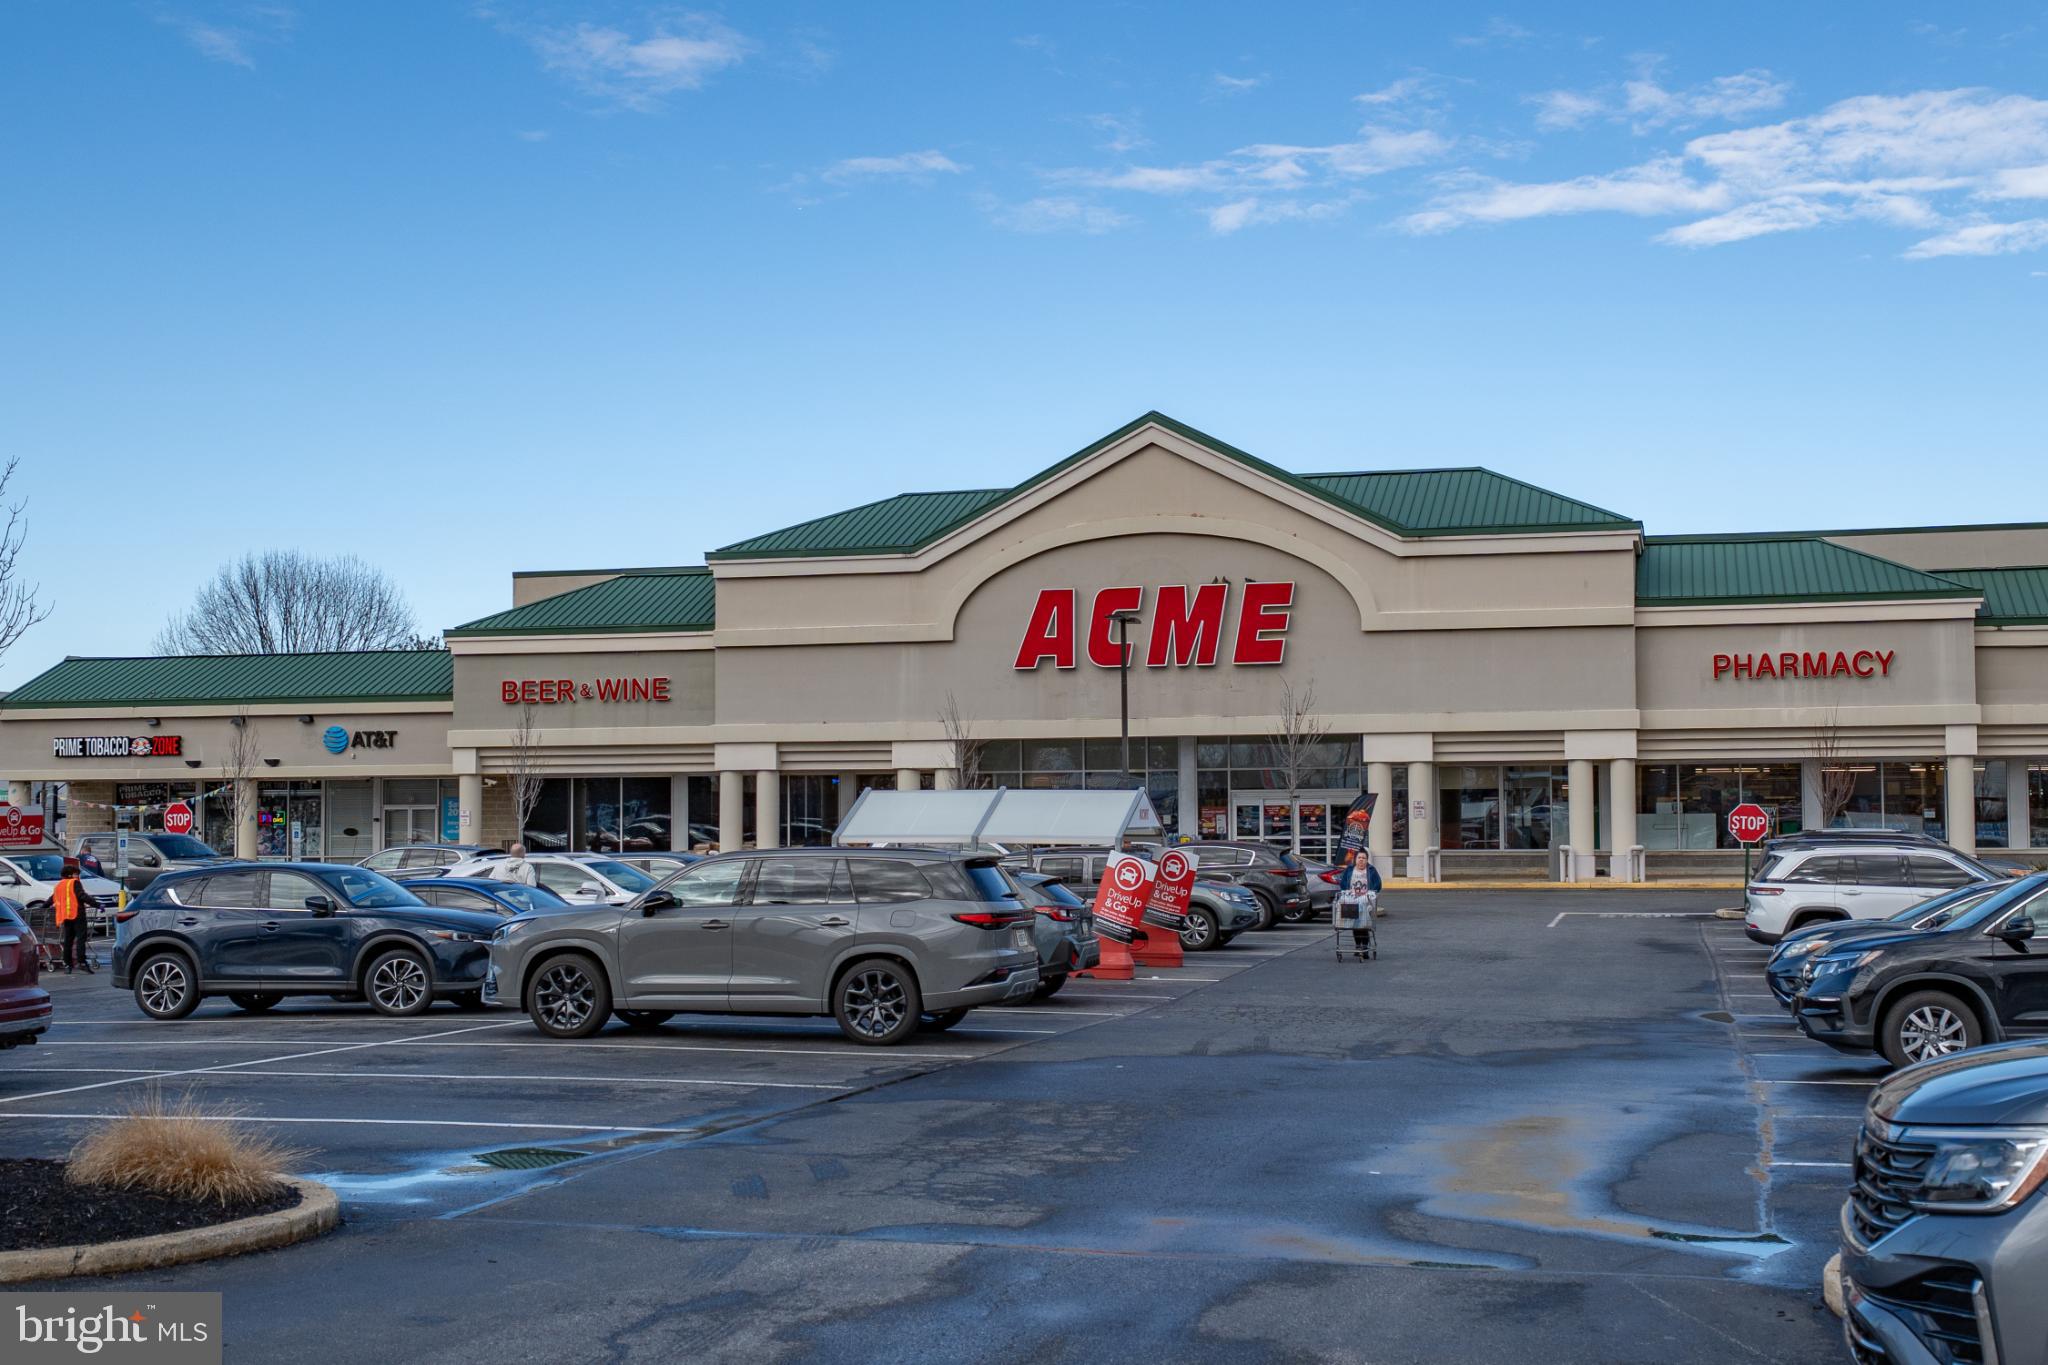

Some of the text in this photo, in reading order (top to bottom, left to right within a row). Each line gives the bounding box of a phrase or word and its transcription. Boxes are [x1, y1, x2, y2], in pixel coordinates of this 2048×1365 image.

[1013, 581, 1296, 670] ACME
[1713, 650, 1894, 679] PHARMACY
[501, 677, 669, 702] BEER & WINE
[54, 736, 180, 756] PRIME TOBACCO ZONE
[350, 730, 398, 748] AT&T
[167, 813, 190, 826] STOP
[1731, 815, 1765, 830] STOP
[20, 825, 27, 835] &
[28, 825, 41, 835] Go
[1153, 890, 1174, 902] & Go
[1155, 880, 1188, 897] DriveUp
[1105, 898, 1127, 913] & Go
[1107, 888, 1142, 908] DriveUp
